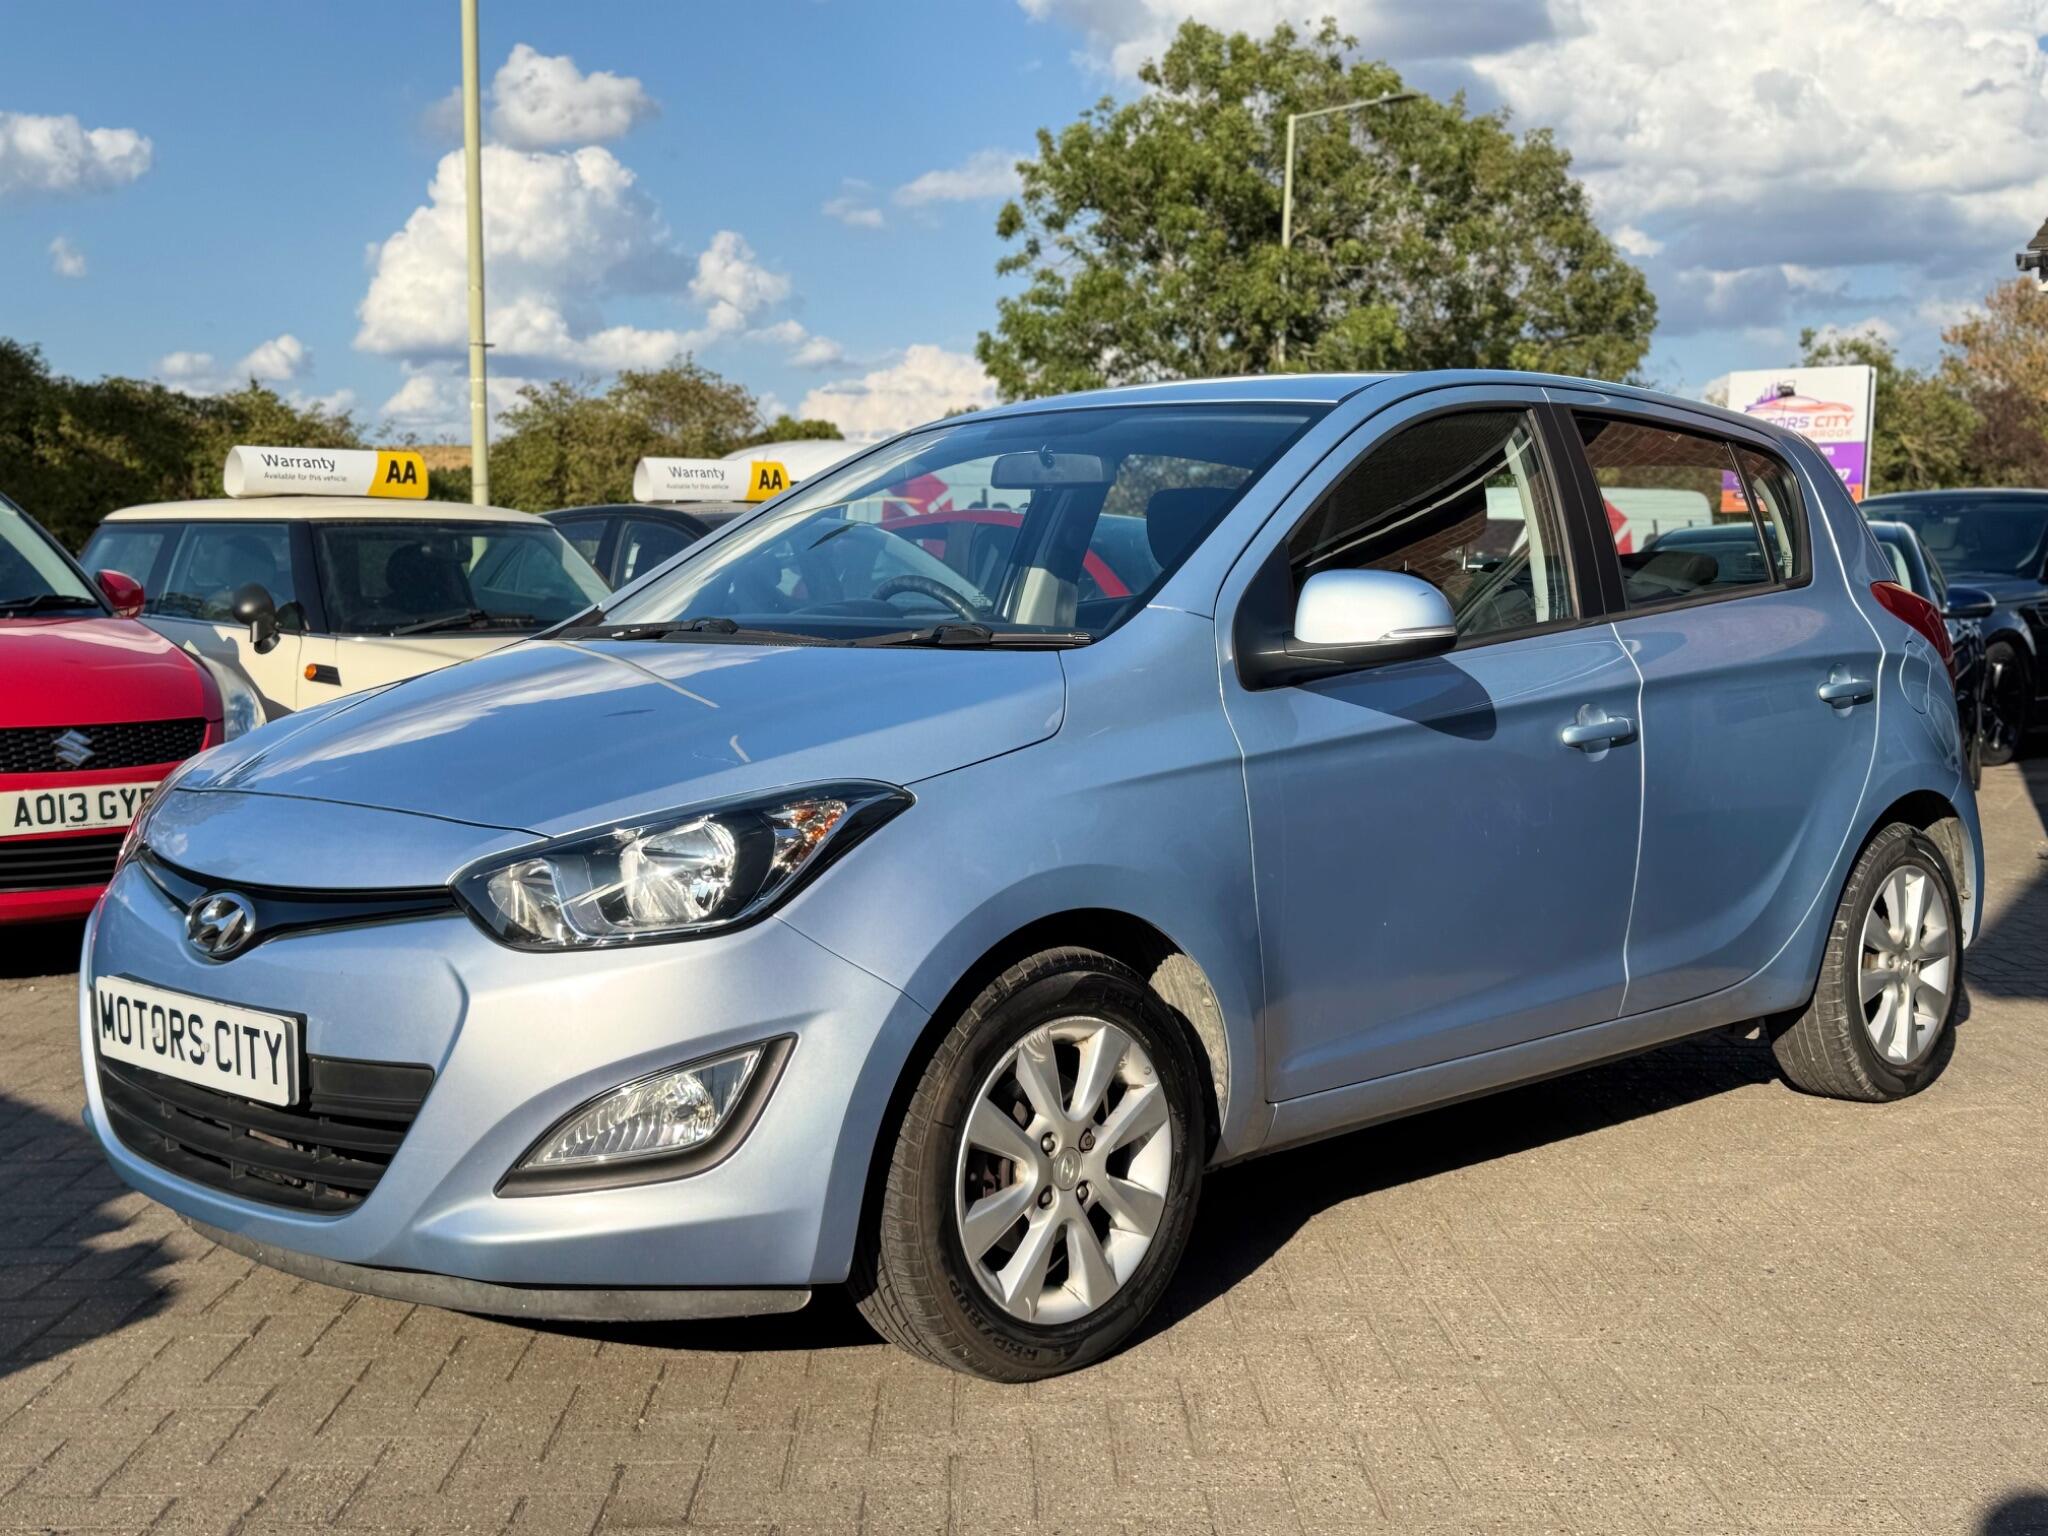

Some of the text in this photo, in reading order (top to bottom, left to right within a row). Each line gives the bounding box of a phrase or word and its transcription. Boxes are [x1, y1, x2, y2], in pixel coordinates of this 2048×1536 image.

[1766, 415, 1855, 430] TORS CITY
[261, 453, 336, 473] Warranty
[385, 459, 417, 484] AA
[263, 471, 296, 480] Available
[298, 473, 308, 481] for
[308, 473, 322, 482] this
[668, 466, 725, 481] Warranty
[758, 469, 783, 490] AA
[100, 990, 282, 1085] MOTORS CITY
